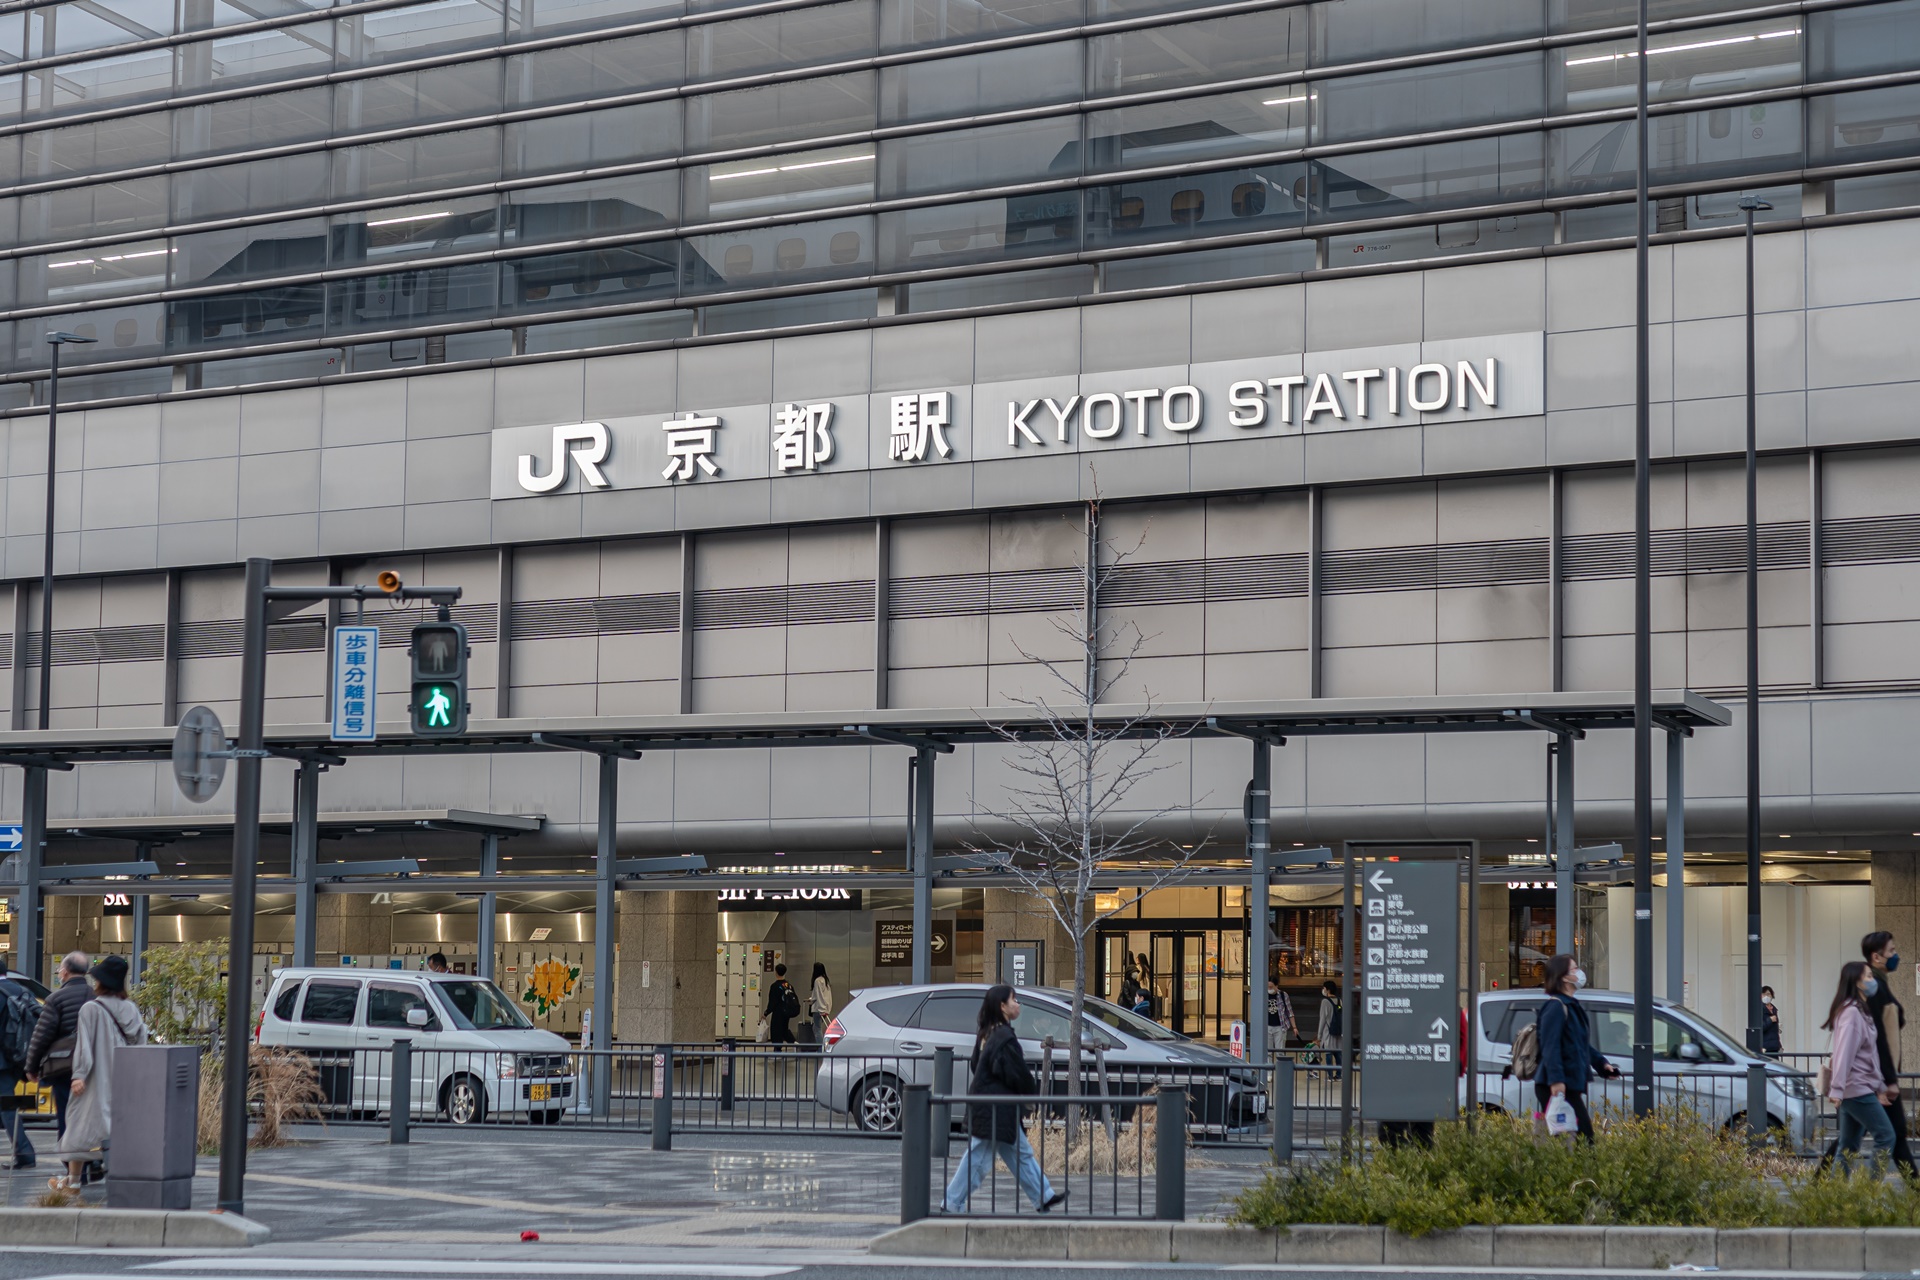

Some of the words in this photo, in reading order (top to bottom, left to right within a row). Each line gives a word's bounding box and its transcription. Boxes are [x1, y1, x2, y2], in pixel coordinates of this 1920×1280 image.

[1353, 245, 1364, 253] JR
[518, 422, 611, 494] JR
[661, 392, 951, 480] 京都駅
[1008, 385, 1207, 448] KYOTO
[1228, 356, 1500, 428] STATION
[343, 634, 367, 732] 歩車分離信号
[1387, 900, 1404, 910] 東寺
[1387, 924, 1428, 934] 梅小路公園
[1387, 949, 1428, 959] 京都水族館
[1387, 973, 1444, 983] 京都鉄道博物館
[1386, 998, 1411, 1008] 近鉄線
